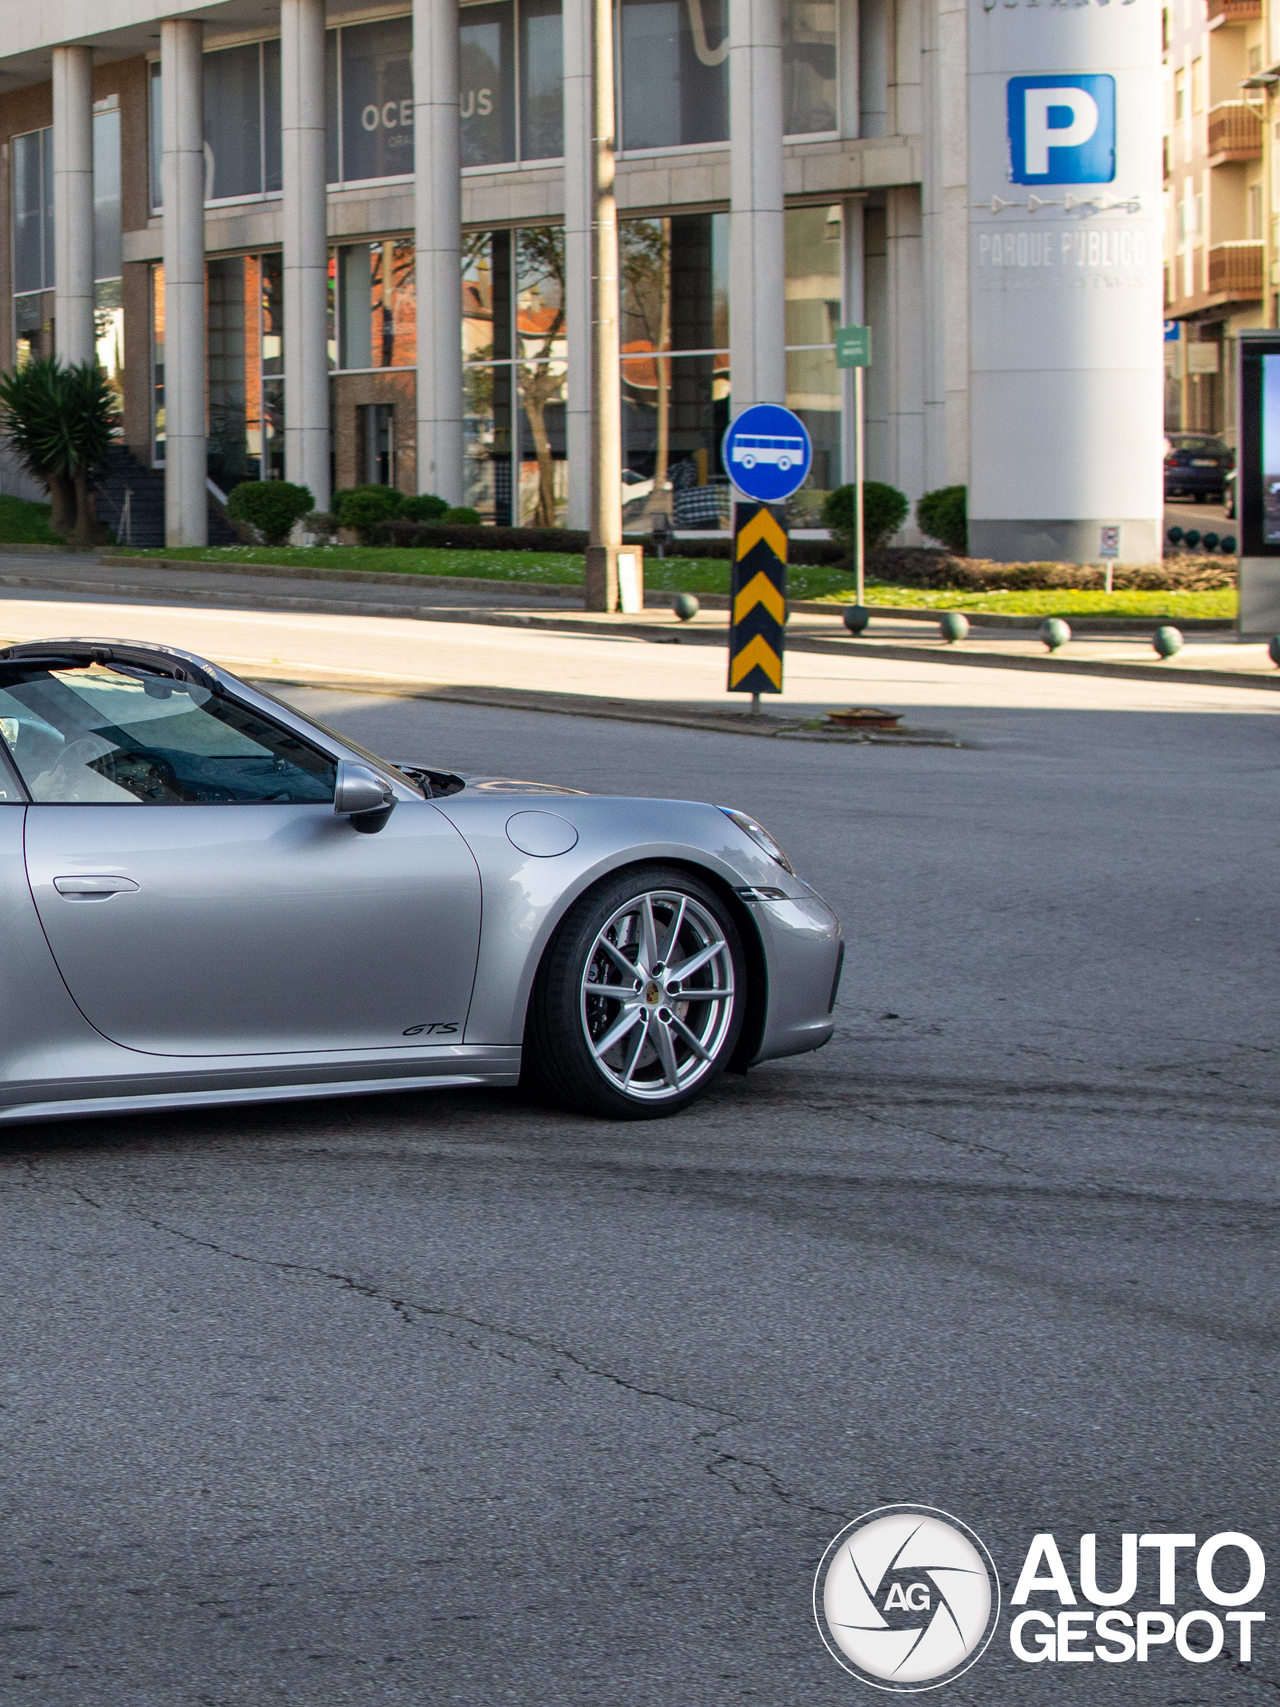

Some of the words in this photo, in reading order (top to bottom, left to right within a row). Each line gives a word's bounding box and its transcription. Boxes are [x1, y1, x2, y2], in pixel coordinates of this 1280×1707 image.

[361, 88, 493, 131] OCEUS
[1024, 87, 1097, 175] P
[978, 232, 1054, 267] PARQUE
[402, 1022, 459, 1036] GTS
